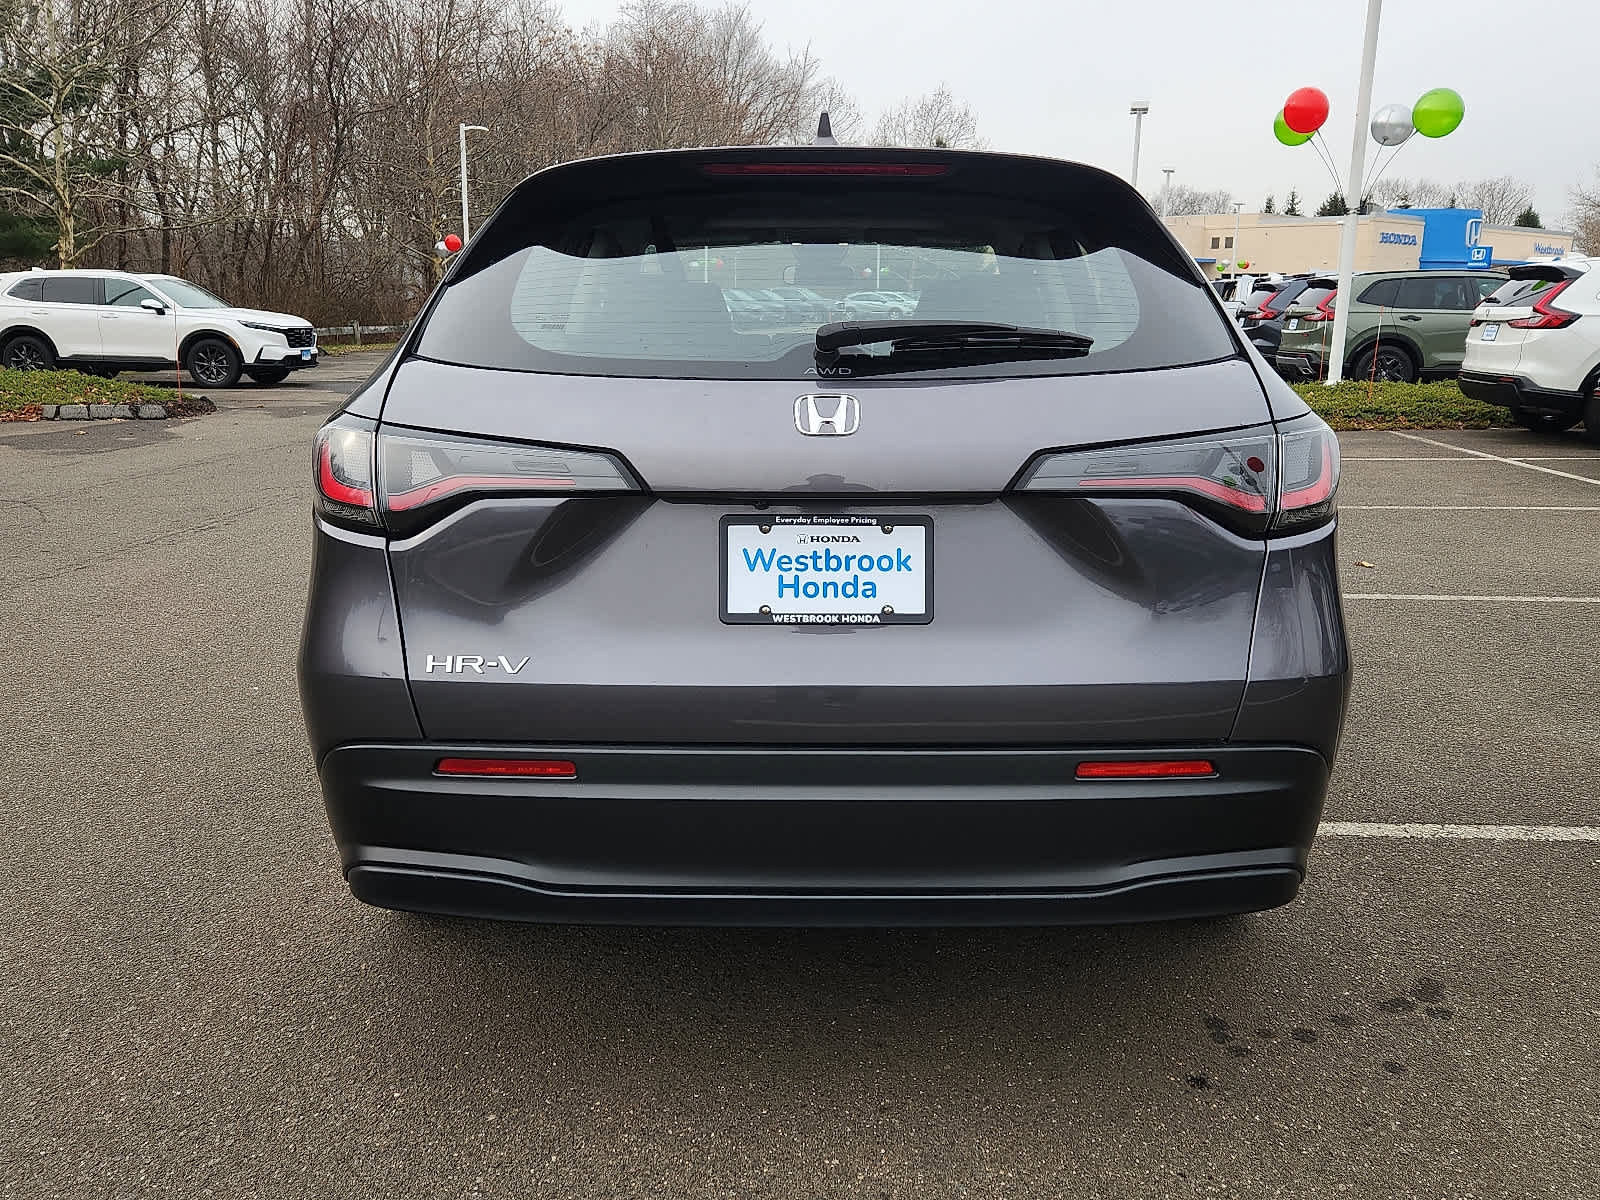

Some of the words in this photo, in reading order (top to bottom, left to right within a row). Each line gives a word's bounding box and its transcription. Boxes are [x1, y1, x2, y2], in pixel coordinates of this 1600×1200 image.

[1379, 232, 1417, 246] HONDA
[803, 367, 852, 375] AWD
[775, 516, 811, 525] Everyday
[813, 516, 849, 525] Employee
[851, 516, 877, 525] Pricing
[810, 535, 861, 543] HONDA
[742, 547, 912, 573] Westbrook
[777, 574, 877, 599] Honda
[772, 614, 839, 623] WESTBROOK
[841, 614, 881, 623] HONDA
[425, 655, 530, 674] HR-V
